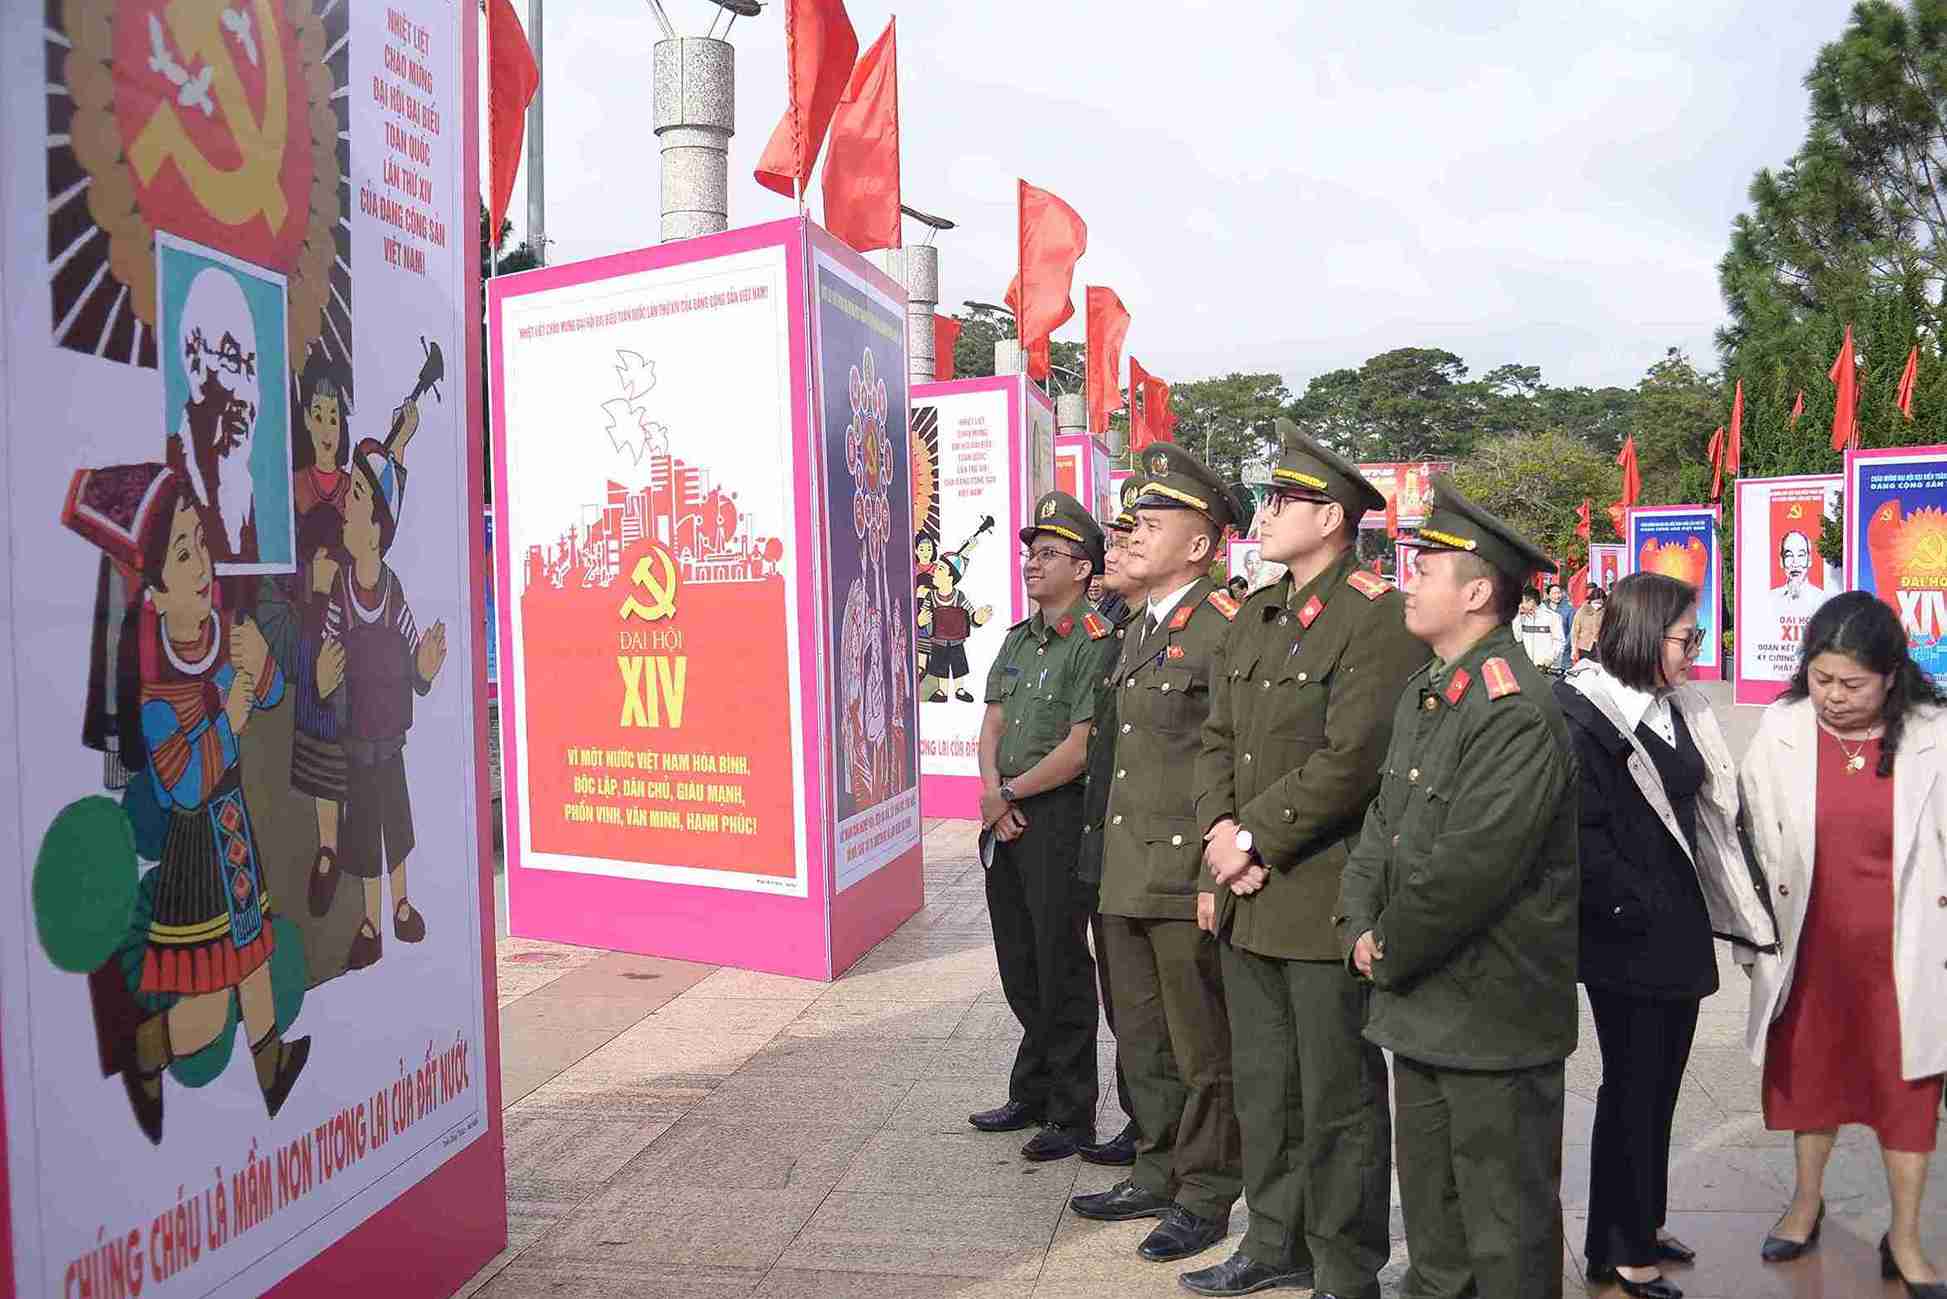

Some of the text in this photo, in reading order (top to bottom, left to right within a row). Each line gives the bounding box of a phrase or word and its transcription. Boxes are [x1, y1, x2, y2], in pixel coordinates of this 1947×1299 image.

[413, 25, 430, 56] LIỆT
[384, 43, 432, 94] CHÀO MỪNG
[373, 75, 439, 135] ĐẠI HỘI ĐẠI BIỂU
[384, 121, 430, 167] TOÀN QUỐC
[384, 154, 432, 204] LẦN THỨ XIV
[360, 179, 445, 248] CỦA ĐẢNG CỘNG SẢN
[384, 234, 401, 269] VIỆT
[620, 626, 682, 652] ĐẠI HỘI
[617, 655, 687, 728] XIV
[567, 746, 578, 766] VÌ
[581, 747, 603, 769] MỘT
[606, 746, 634, 768] NƯỚC
[637, 749, 658, 773] VIỆT
[663, 752, 690, 772] NAM
[693, 749, 716, 773] HÒA
[574, 774, 596, 797] ĐỘC
[623, 777, 645, 798] DÂN
[677, 780, 704, 801] GIÀU
[625, 806, 647, 827] VĂN
[687, 812, 719, 834] HẠNH
[721, 813, 758, 834] PHÚC!
[148, 1183, 200, 1282] CHÁU
[206, 1166, 227, 1250] LÀ
[233, 1136, 272, 1237] MẦM
[278, 1132, 312, 1208] NON
[369, 1088, 388, 1149] LAI
[392, 1056, 414, 1135] CỦA
[417, 1040, 437, 1120] ĐẤT
[441, 1030, 468, 1104] NƯỚC
